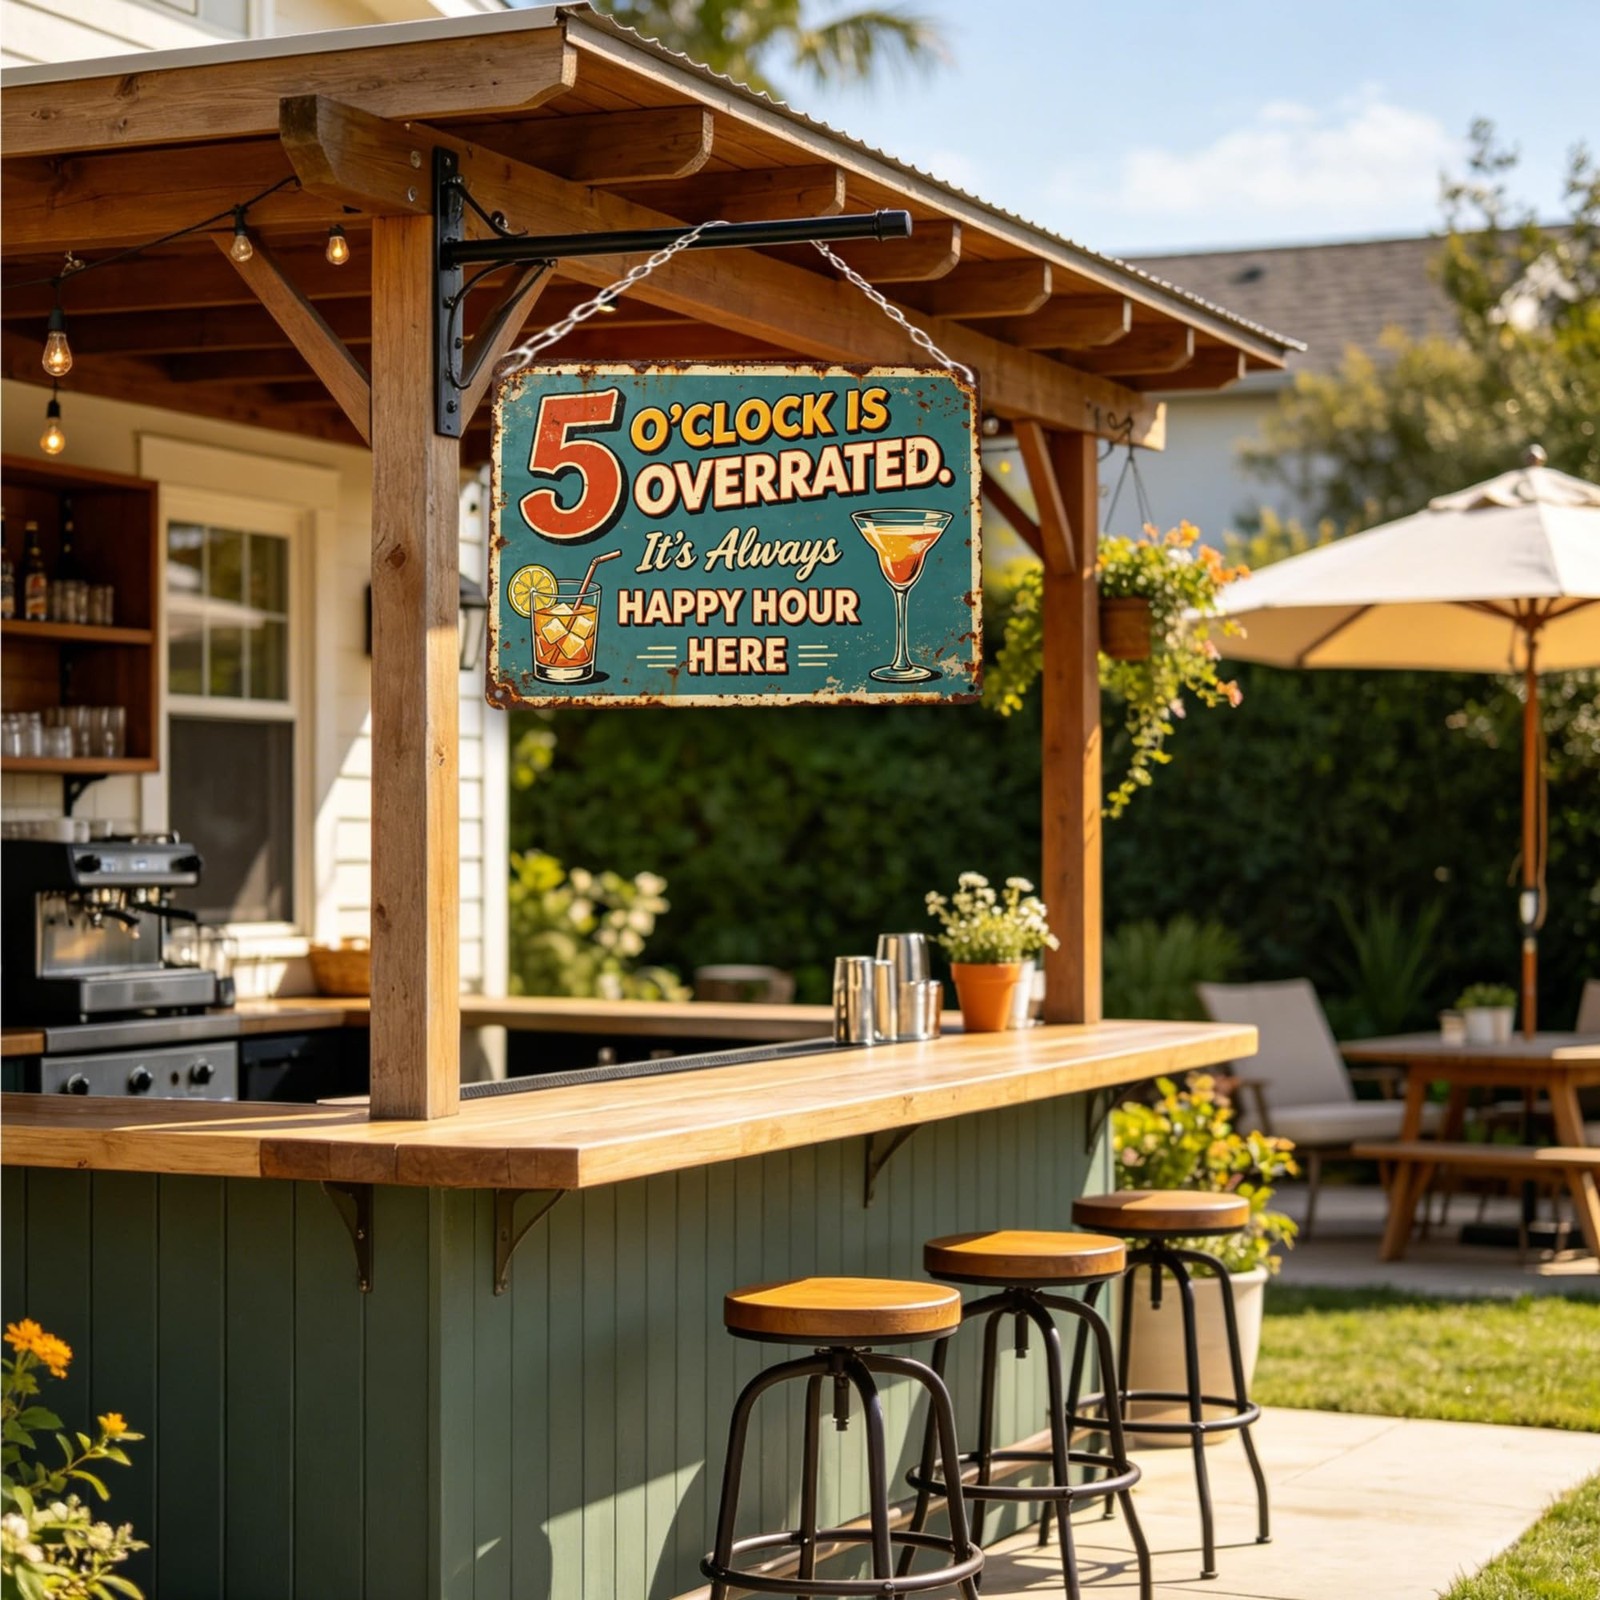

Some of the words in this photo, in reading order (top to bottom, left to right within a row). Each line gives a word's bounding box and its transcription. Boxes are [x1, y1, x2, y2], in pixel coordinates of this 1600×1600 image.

[519, 388, 622, 542] 5
[845, 387, 889, 432] IS
[634, 436, 954, 517] OVERRATED.
[704, 526, 841, 581] Always
[617, 589, 742, 626] HAPPY
[752, 588, 861, 625] HOUR
[687, 637, 788, 674] HERE
